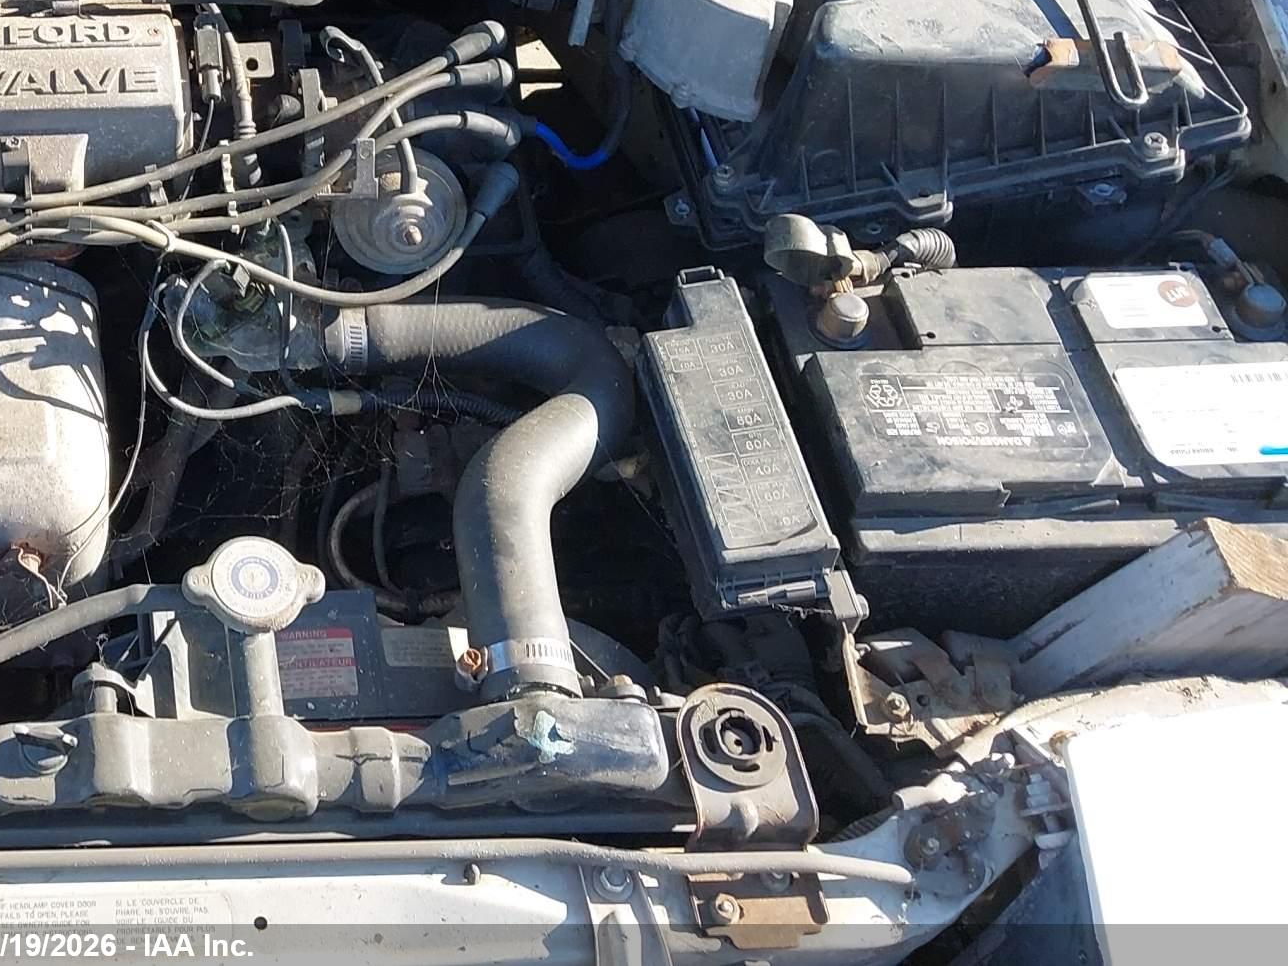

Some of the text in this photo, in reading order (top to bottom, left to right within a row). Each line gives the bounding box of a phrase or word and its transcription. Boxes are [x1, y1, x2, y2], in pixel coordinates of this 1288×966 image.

[3, 20, 134, 45] FORD
[710, 341, 735, 354] 30A
[718, 365, 744, 378] 30A
[727, 390, 753, 402] 30A
[280, 630, 328, 640] WARNING
[10, 901, 48, 910] HEADLAMP
[51, 900, 75, 909] COVER
